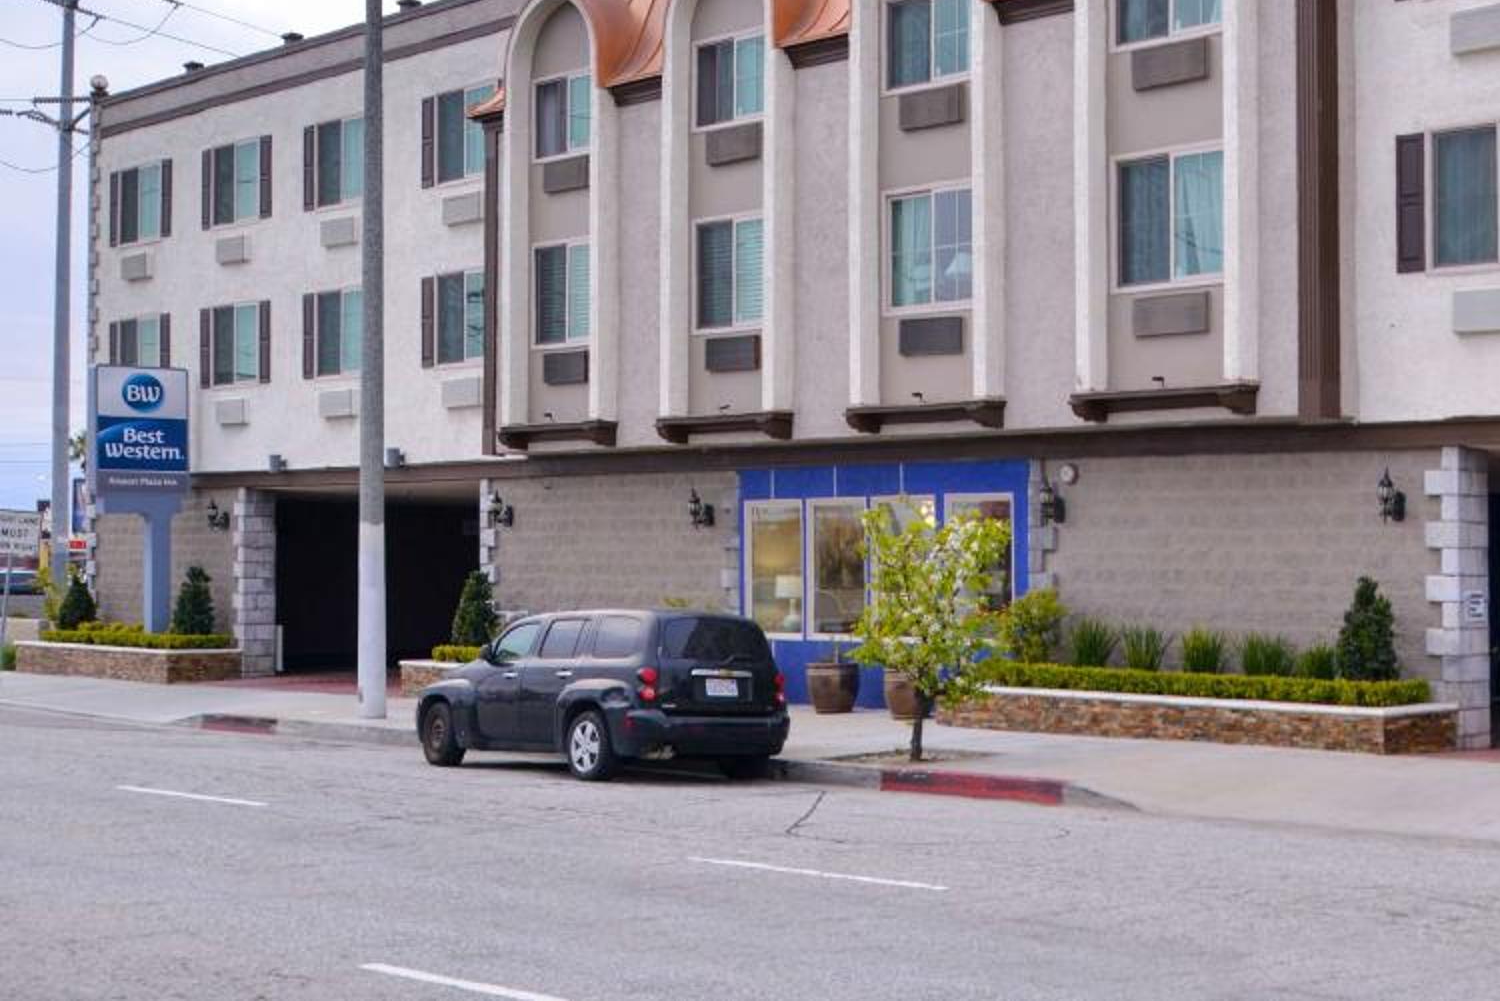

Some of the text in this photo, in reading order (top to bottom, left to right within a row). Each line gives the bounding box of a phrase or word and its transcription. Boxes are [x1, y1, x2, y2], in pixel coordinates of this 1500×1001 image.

[127, 385, 161, 402] BW
[123, 428, 165, 444] Best
[105, 443, 181, 460] Western
[2, 528, 29, 537] MUST
